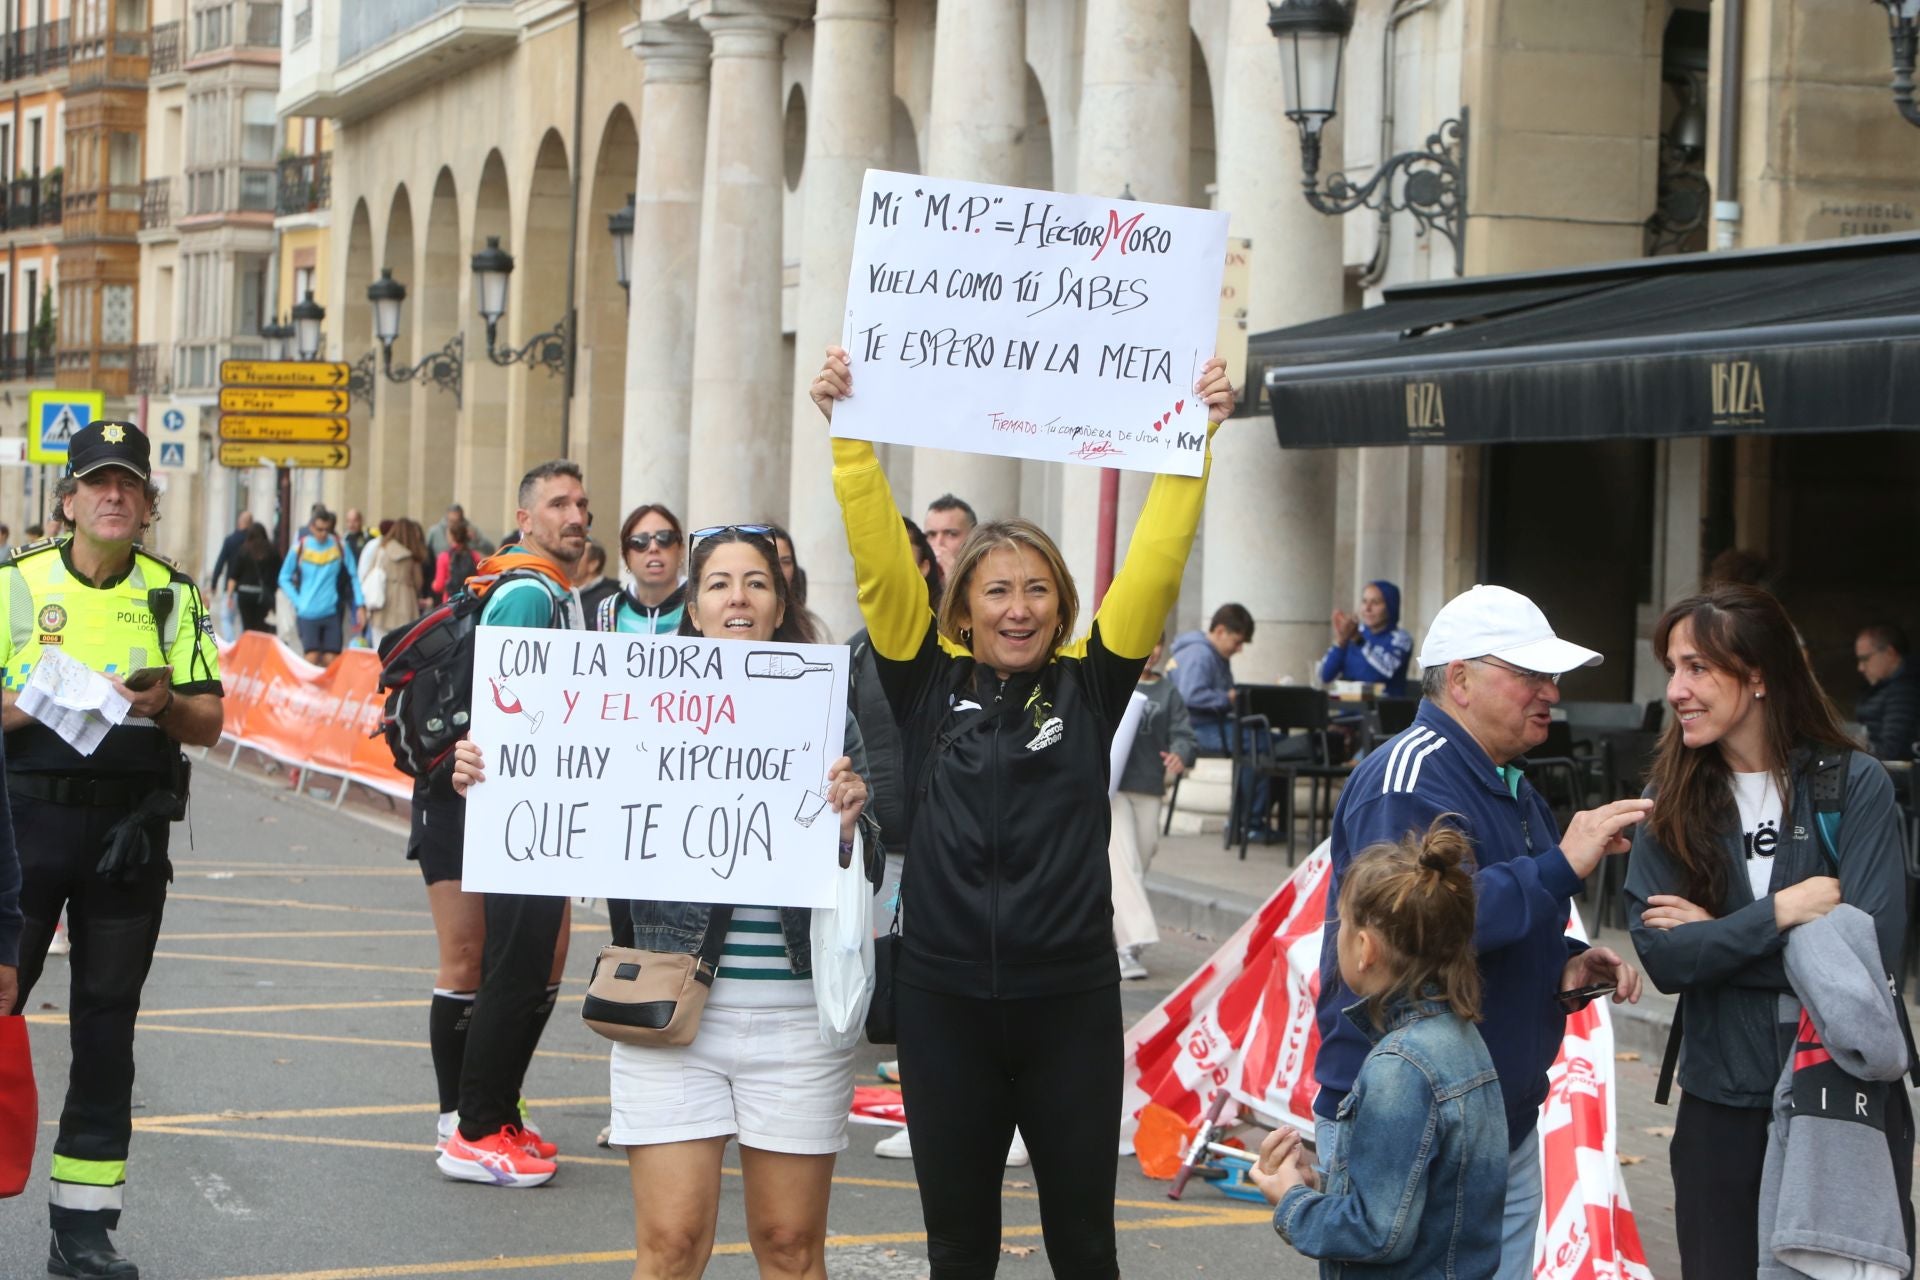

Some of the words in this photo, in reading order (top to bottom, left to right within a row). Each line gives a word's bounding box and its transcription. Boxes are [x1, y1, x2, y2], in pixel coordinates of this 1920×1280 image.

[1091, 209, 1171, 261] MORO
[870, 263, 938, 294] VUELA
[946, 269, 1003, 301] COMO
[1012, 271, 1043, 303] TÚ
[1027, 266, 1149, 318] SABES
[859, 323, 888, 362] TE
[900, 328, 994, 369] ESPERO
[1003, 340, 1040, 370] EN
[1044, 343, 1079, 375] LA
[1099, 343, 1171, 384] META
[1711, 361, 1765, 415] IBIZA
[1118, 430, 1132, 441] DE
[1135, 431, 1159, 444] VIDA
[1177, 431, 1205, 452] KM
[499, 639, 551, 678] CON
[573, 641, 607, 677] LA
[562, 689, 581, 725] Y
[600, 693, 640, 721] EL
[499, 743, 537, 778] NO
[556, 745, 611, 780] HAY
[504, 799, 589, 862] QUE
[620, 803, 663, 861] TE
[1791, 1087, 1868, 1117] IR
